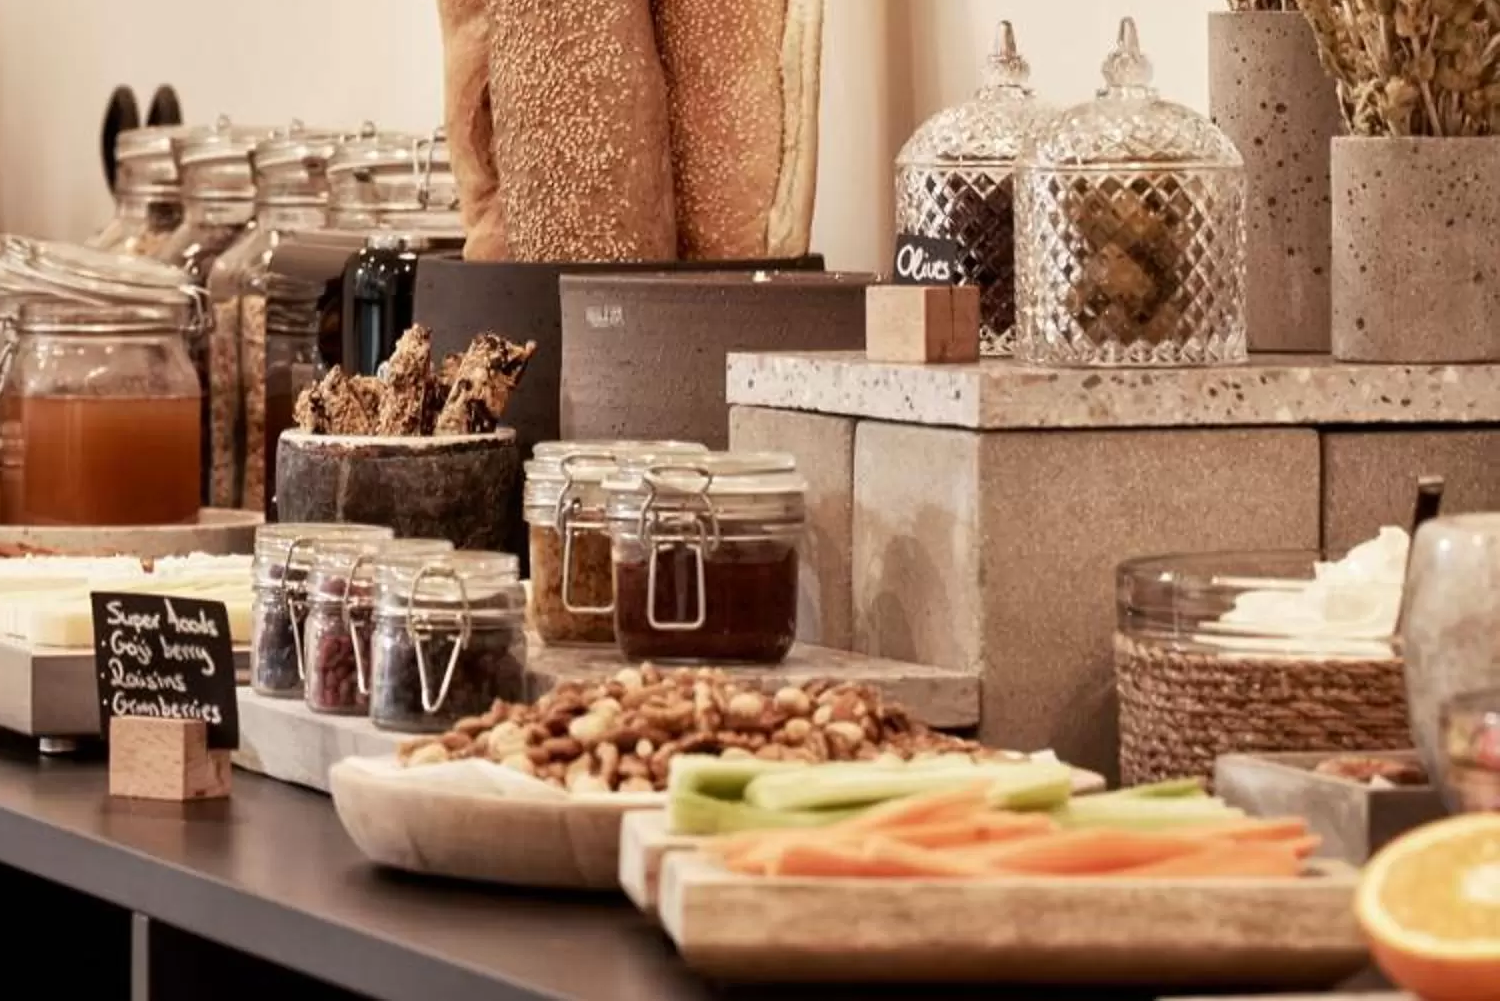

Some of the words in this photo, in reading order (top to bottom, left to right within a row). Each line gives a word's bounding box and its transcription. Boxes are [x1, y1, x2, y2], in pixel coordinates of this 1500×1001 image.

[897, 244, 950, 281] Olives
[106, 600, 160, 633] Super
[164, 598, 219, 637] foods
[159, 634, 215, 676] berry
[108, 658, 187, 692] Raisins
